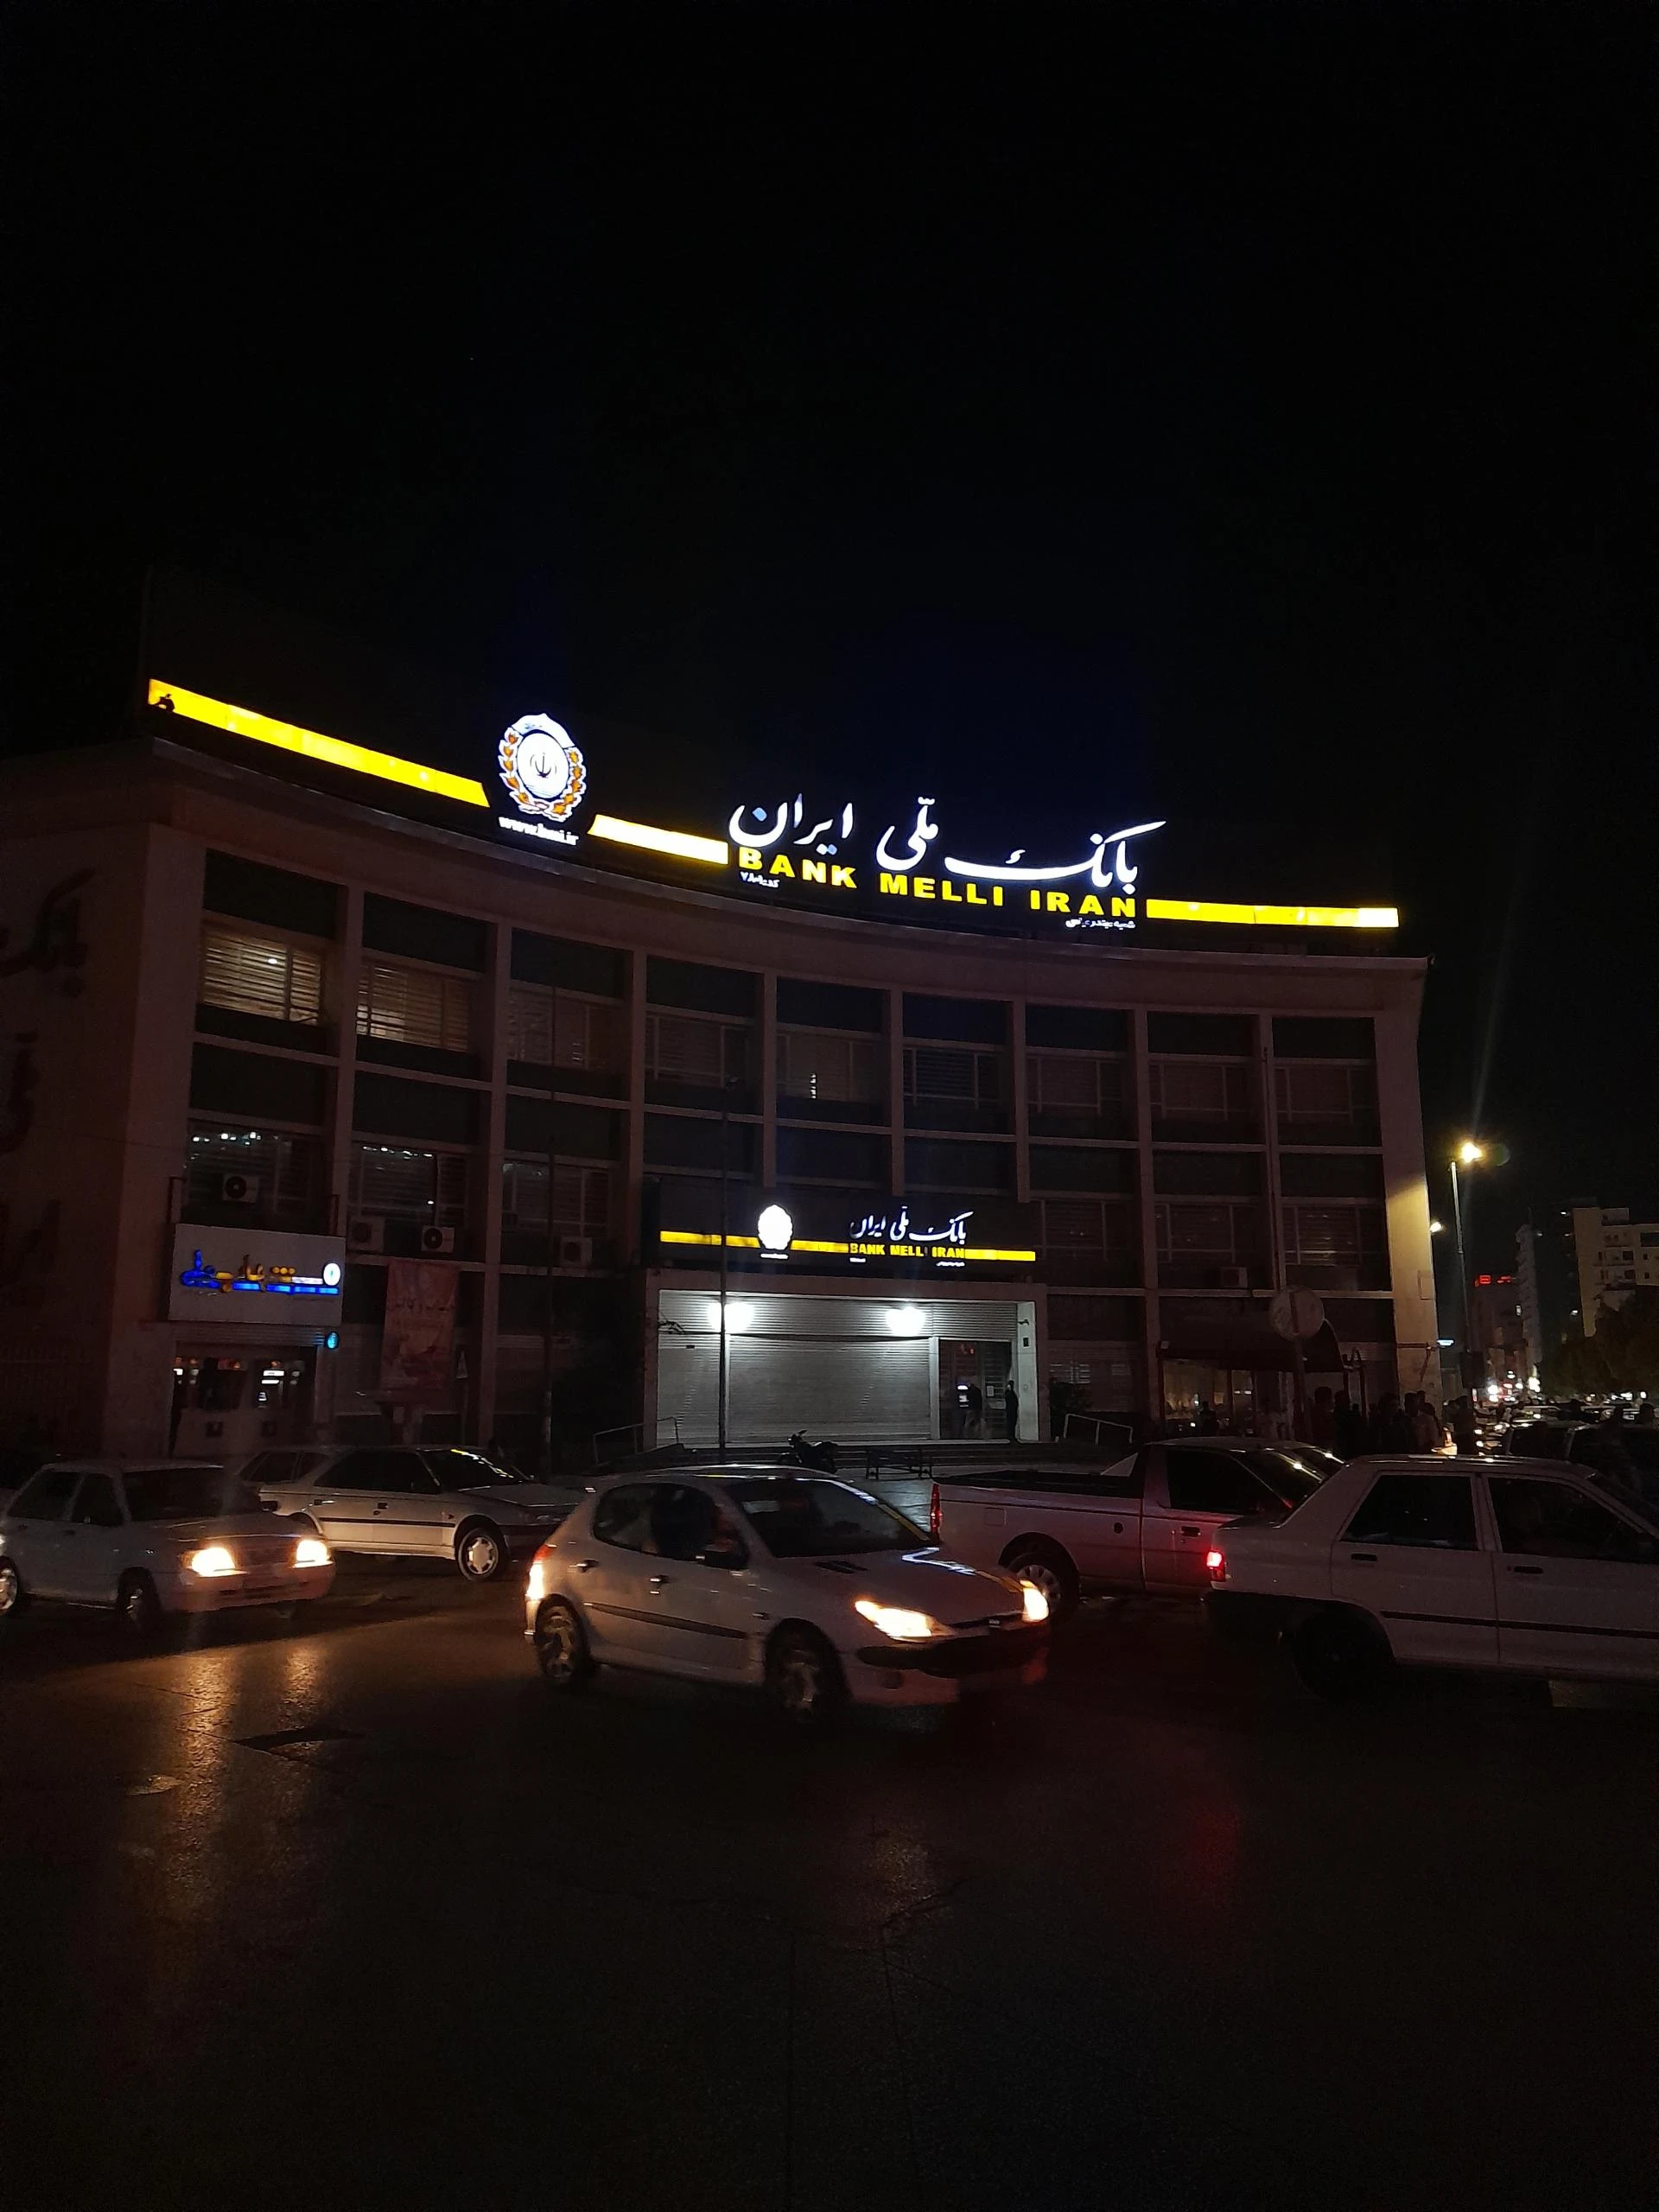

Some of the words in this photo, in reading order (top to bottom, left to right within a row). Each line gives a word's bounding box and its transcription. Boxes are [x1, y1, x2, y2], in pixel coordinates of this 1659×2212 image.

[728, 793, 854, 855] ایران
[739, 844, 857, 889] BANK
[880, 872, 1004, 906] MELLI
[1030, 889, 1136, 918] IRAN
[944, 820, 1166, 895] بانک
[849, 1243, 886, 1255] BANK
[931, 1246, 965, 1259] IRAN
[850, 1215, 887, 1239] ایران
[908, 1211, 974, 1245] بانک
